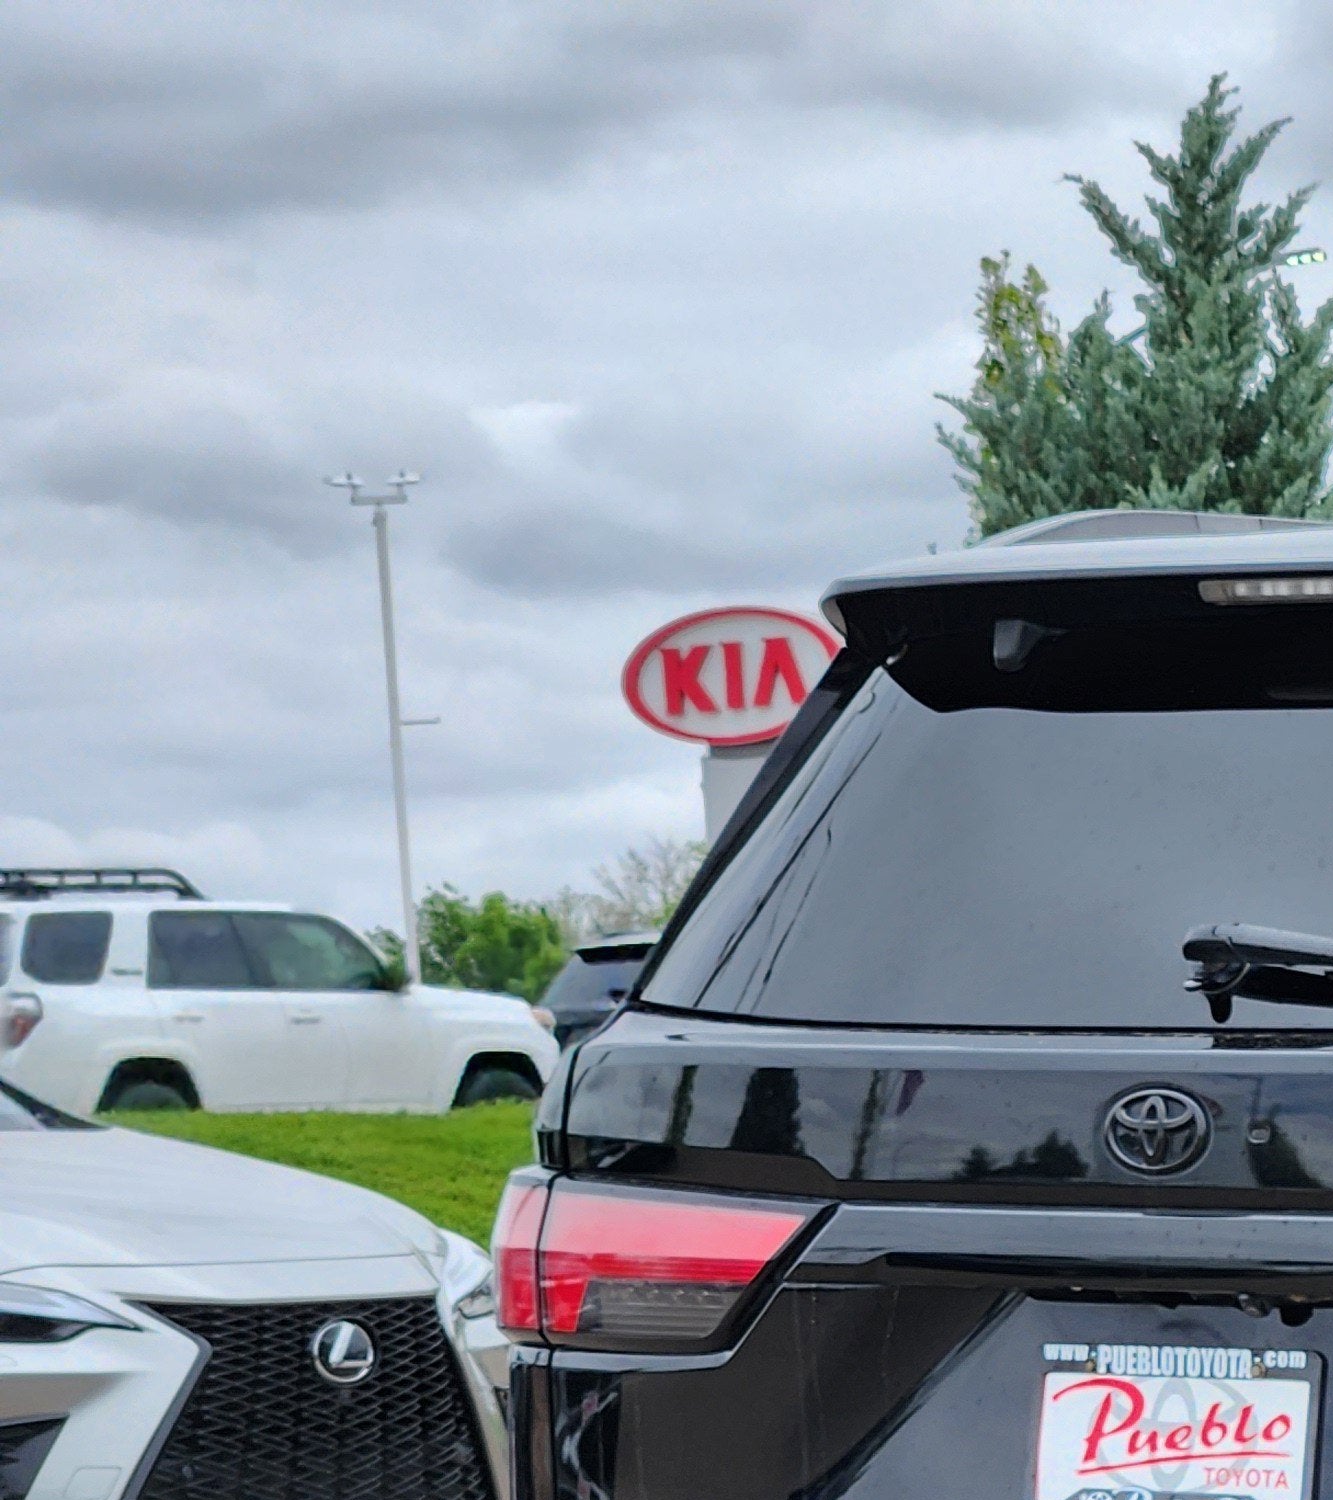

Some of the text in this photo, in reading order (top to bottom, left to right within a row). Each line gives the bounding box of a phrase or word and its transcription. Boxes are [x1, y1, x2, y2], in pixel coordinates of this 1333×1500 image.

[660, 637, 807, 716] KIA
[1053, 1377, 1292, 1463] Pueblo
[1204, 1466, 1290, 1489] TOYOTA
